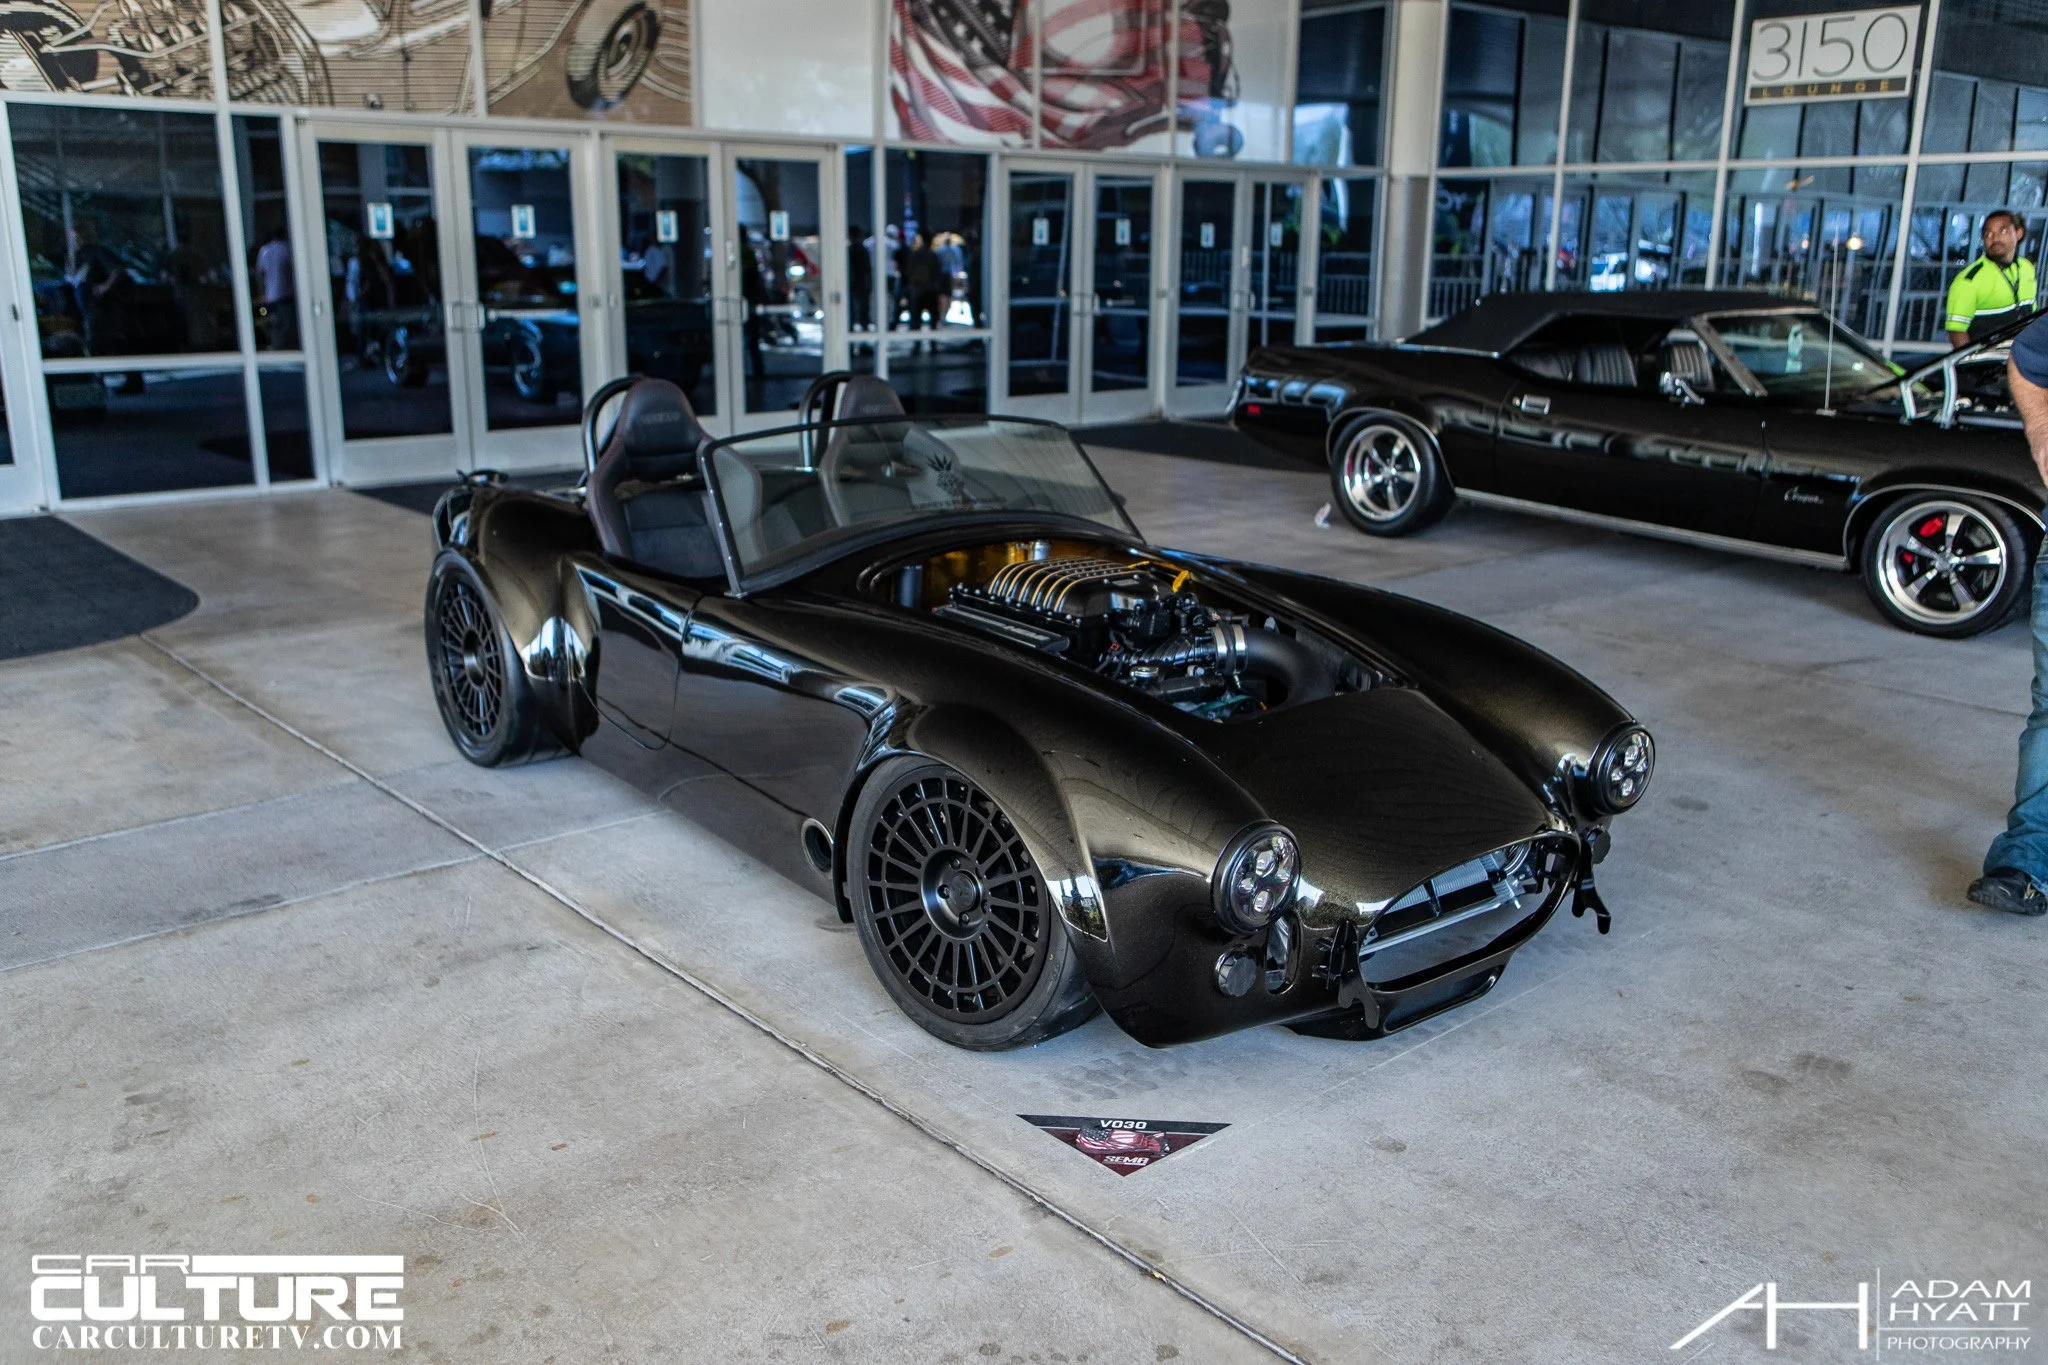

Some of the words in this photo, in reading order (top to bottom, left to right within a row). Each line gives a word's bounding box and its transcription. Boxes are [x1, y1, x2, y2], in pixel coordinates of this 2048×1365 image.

[1752, 12, 1908, 81] 3150
[1762, 79, 1889, 98] LOUNGE
[1103, 1155, 1149, 1166] SEMA
